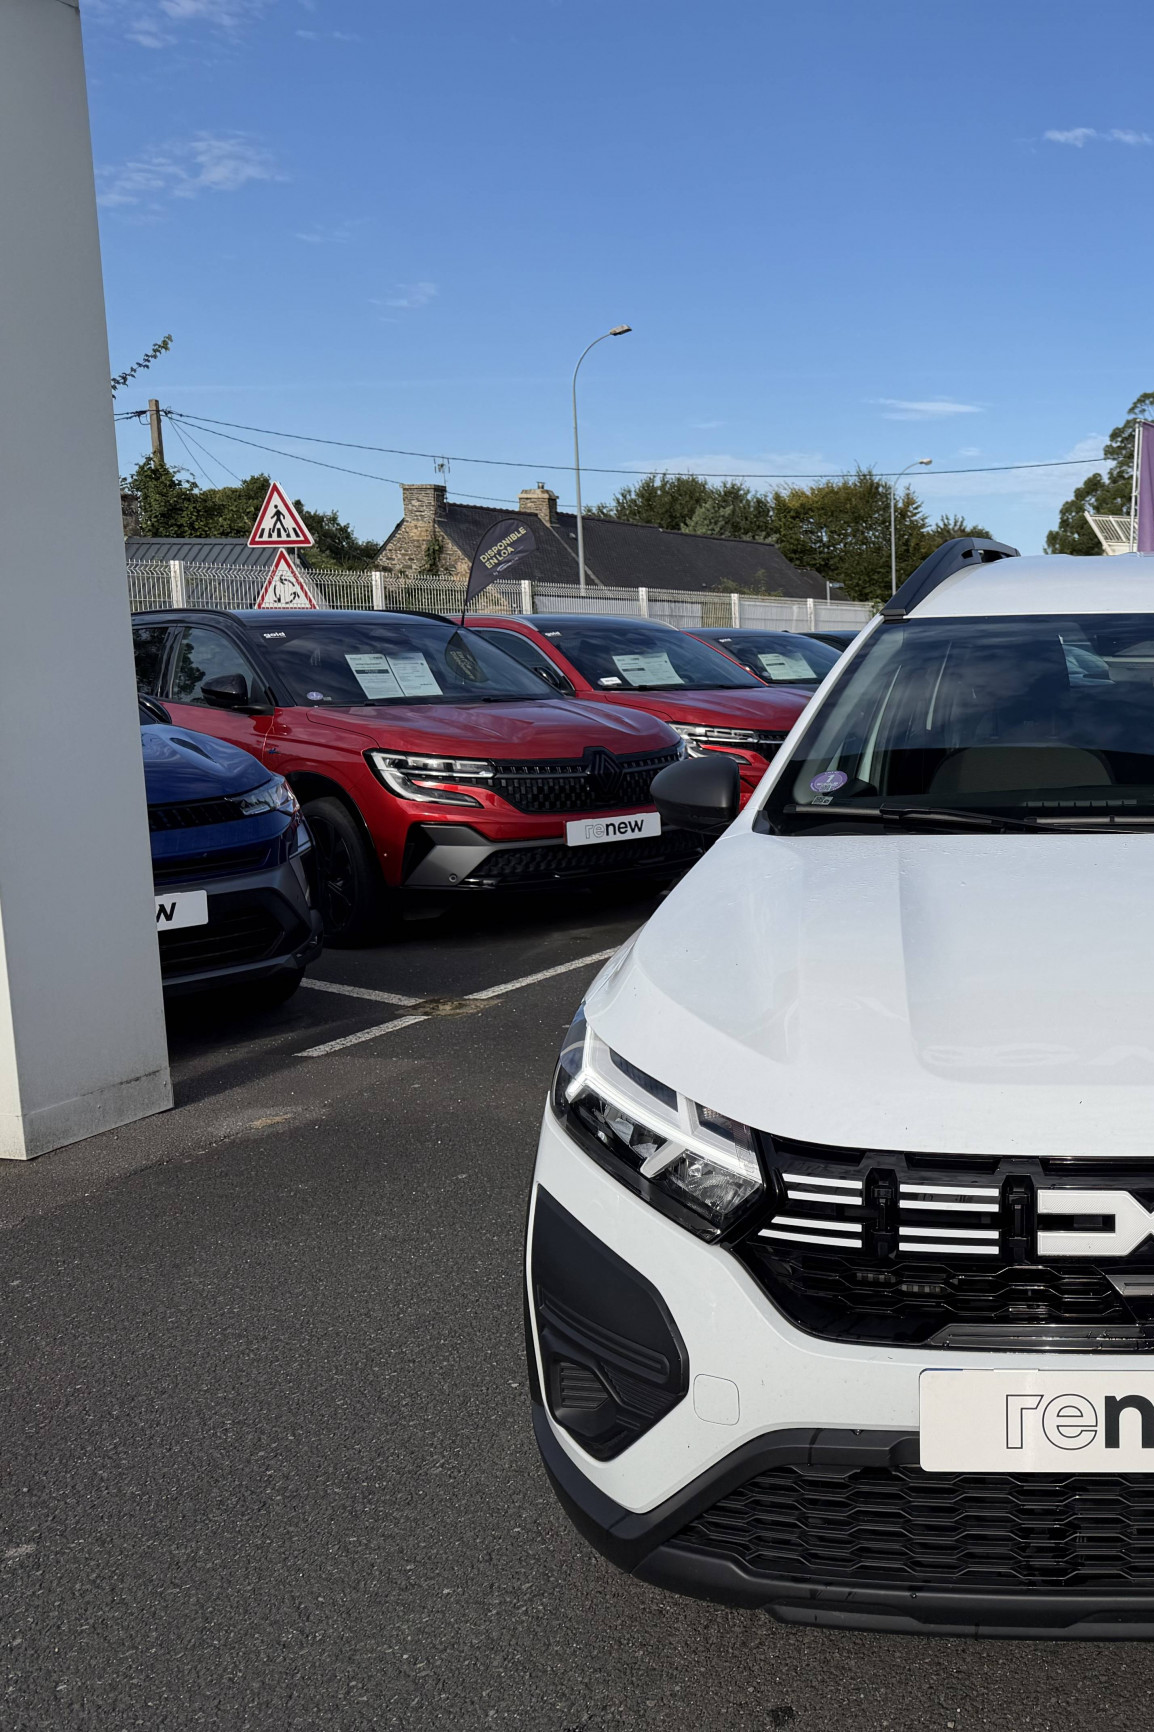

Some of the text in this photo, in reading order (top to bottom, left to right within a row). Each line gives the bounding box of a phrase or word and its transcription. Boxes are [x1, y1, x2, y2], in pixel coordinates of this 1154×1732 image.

[479, 526, 527, 563] DISPONIBLE
[485, 557, 499, 569] EN
[497, 546, 515, 561] LOA
[584, 819, 645, 840] renew
